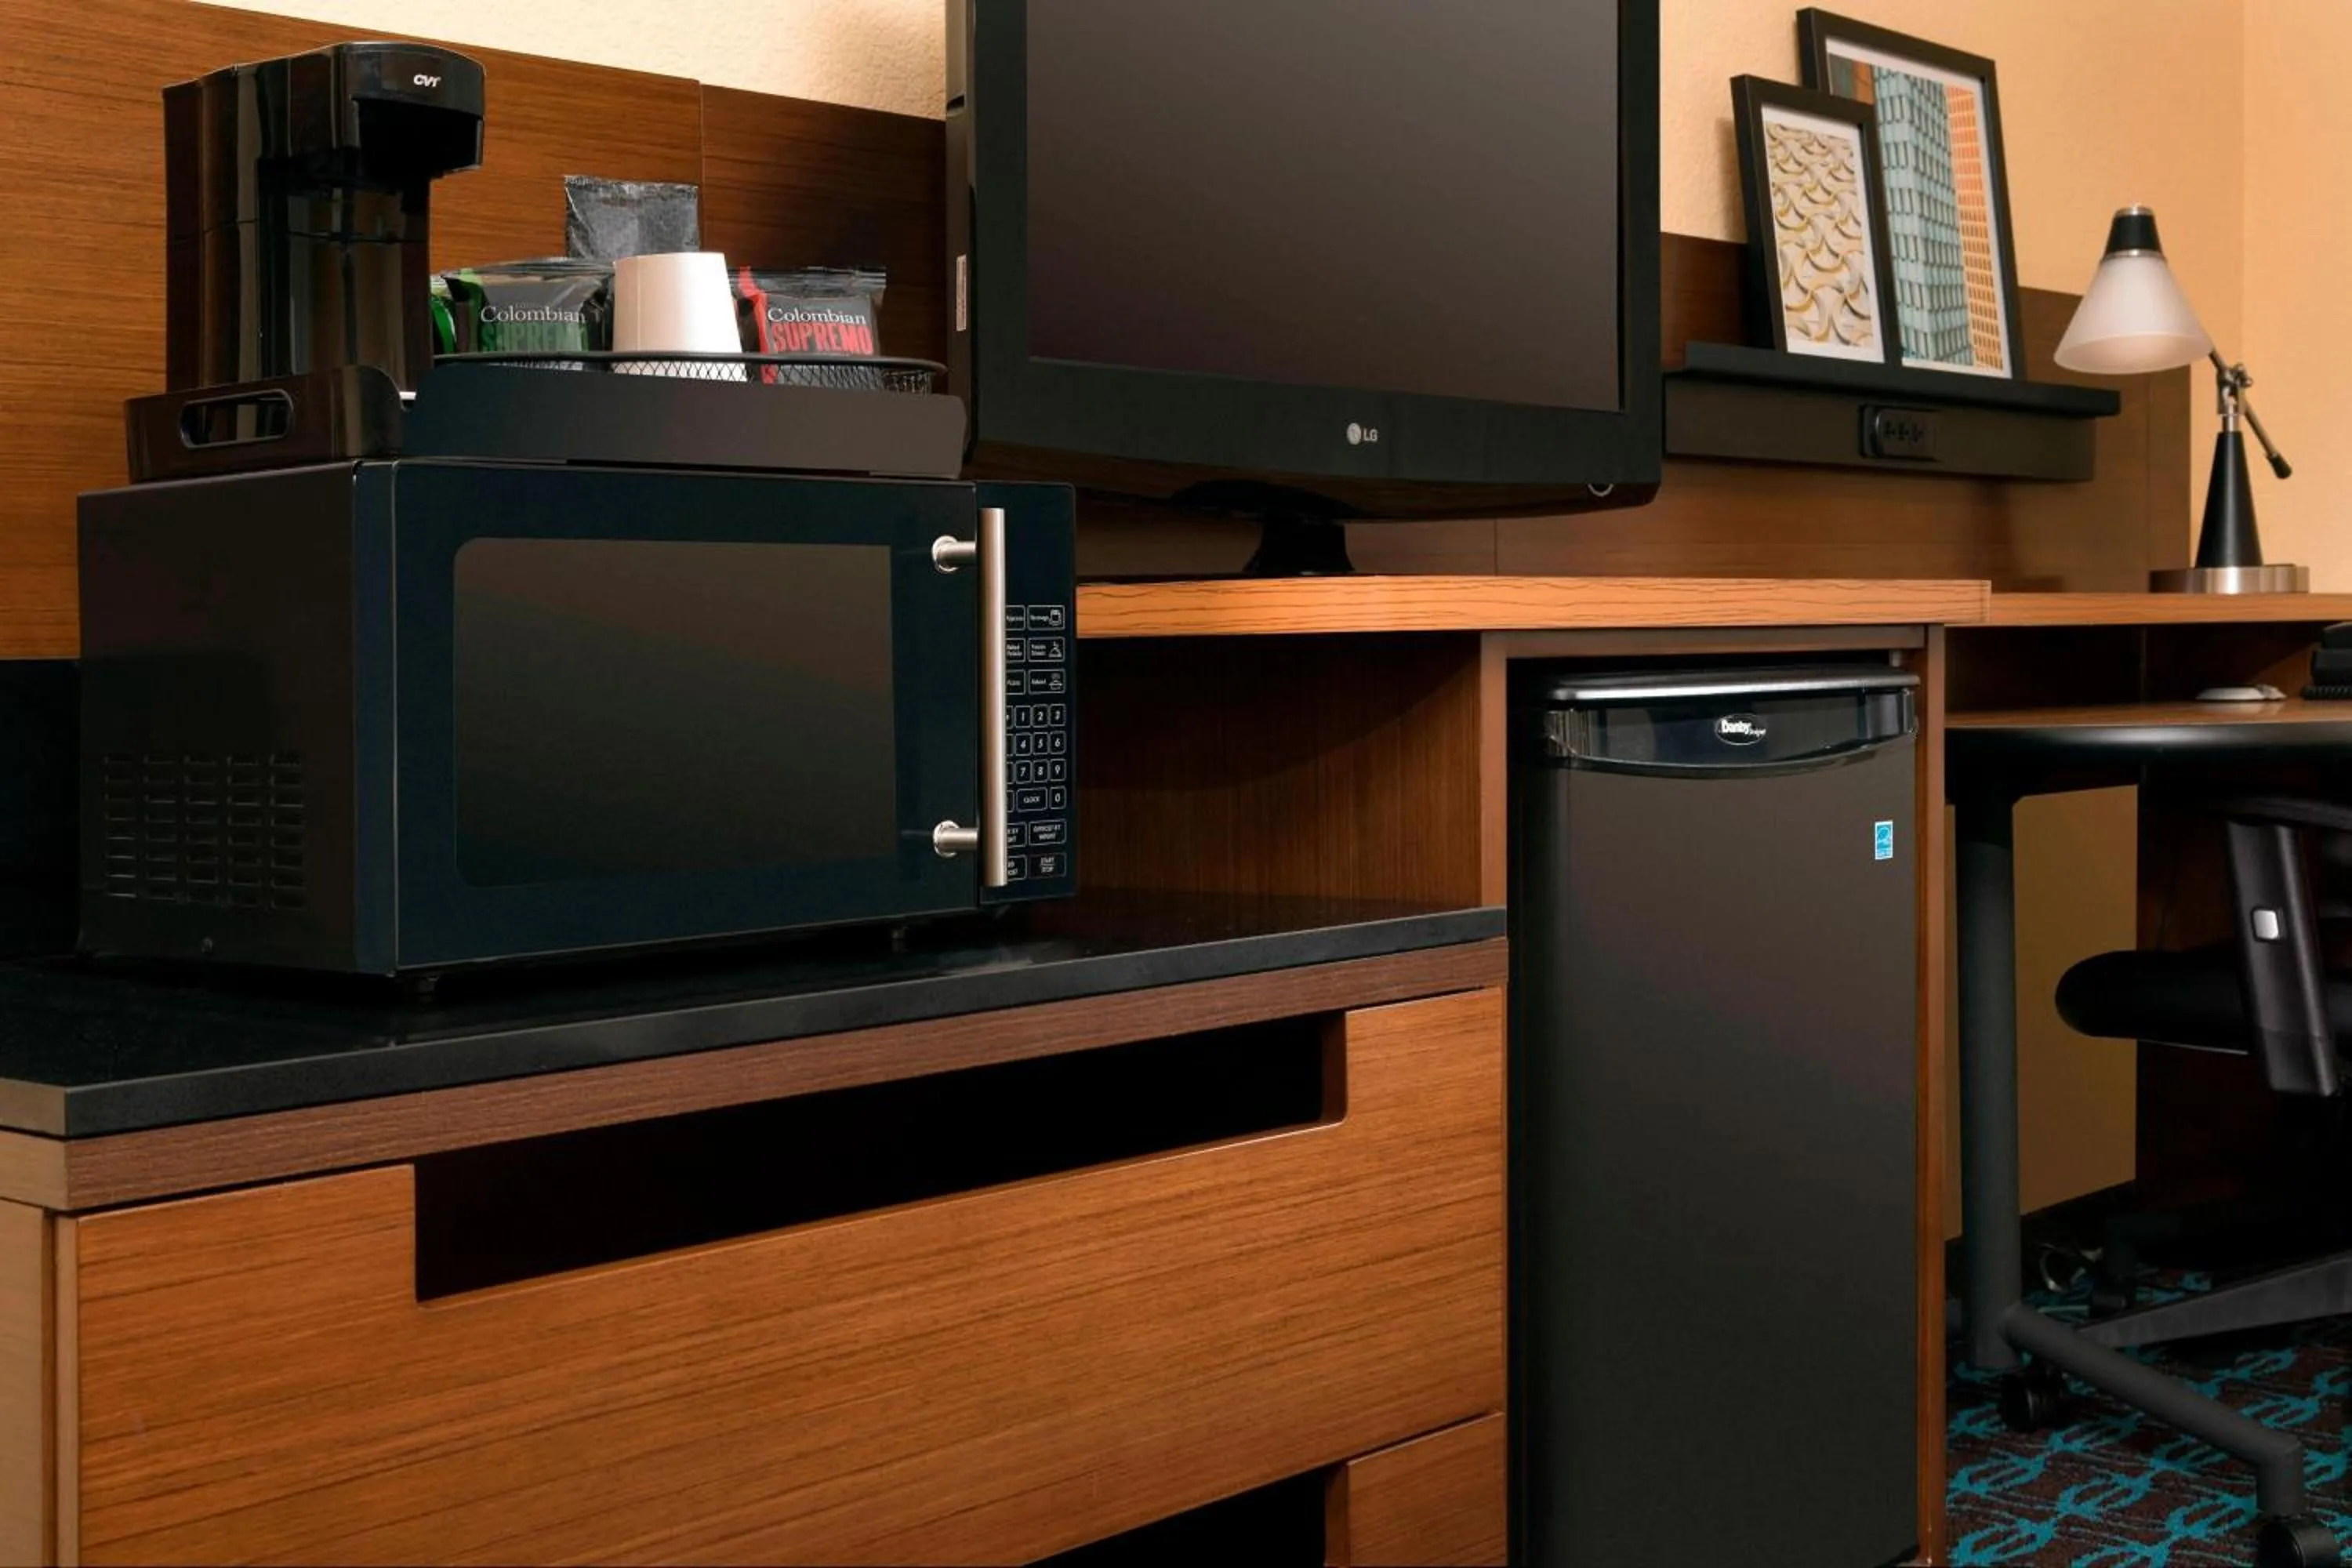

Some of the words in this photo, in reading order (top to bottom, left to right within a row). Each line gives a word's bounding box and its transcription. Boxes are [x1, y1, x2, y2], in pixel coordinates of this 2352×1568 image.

[480, 304, 586, 324] Colombian
[767, 307, 867, 325] Colombian
[771, 322, 874, 355] SUPREMO
[1363, 427, 1378, 443] LG
